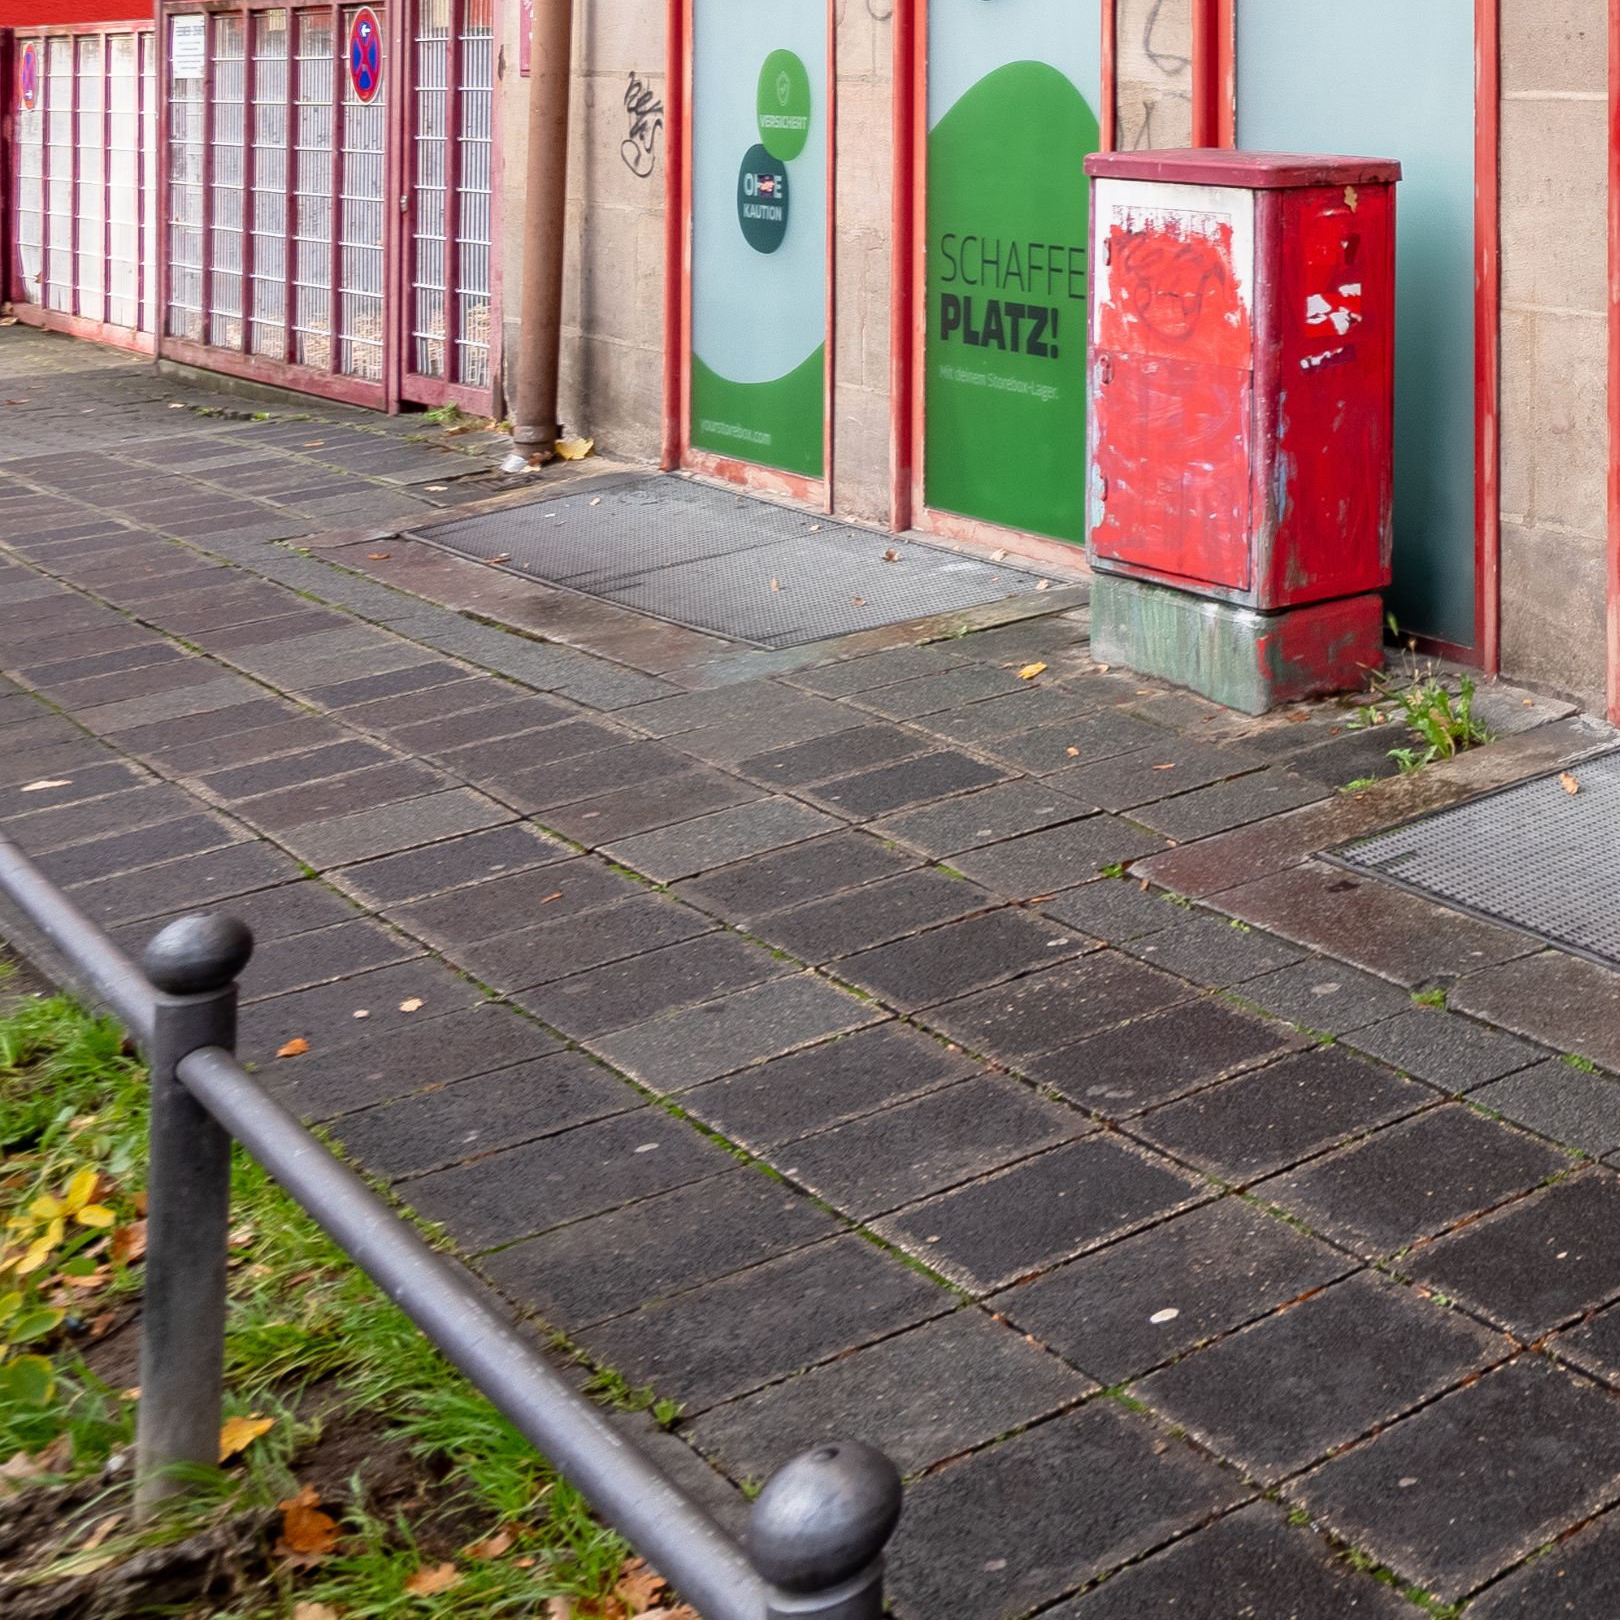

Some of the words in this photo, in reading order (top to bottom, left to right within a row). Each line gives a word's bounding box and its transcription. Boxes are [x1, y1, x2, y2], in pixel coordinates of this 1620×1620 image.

[760, 115, 808, 130] VERSICHERT
[744, 173, 782, 199] OE
[743, 203, 782, 221] KAUTION
[940, 233, 1086, 300] SCHAFFE
[940, 292, 1059, 359] PLATZ!
